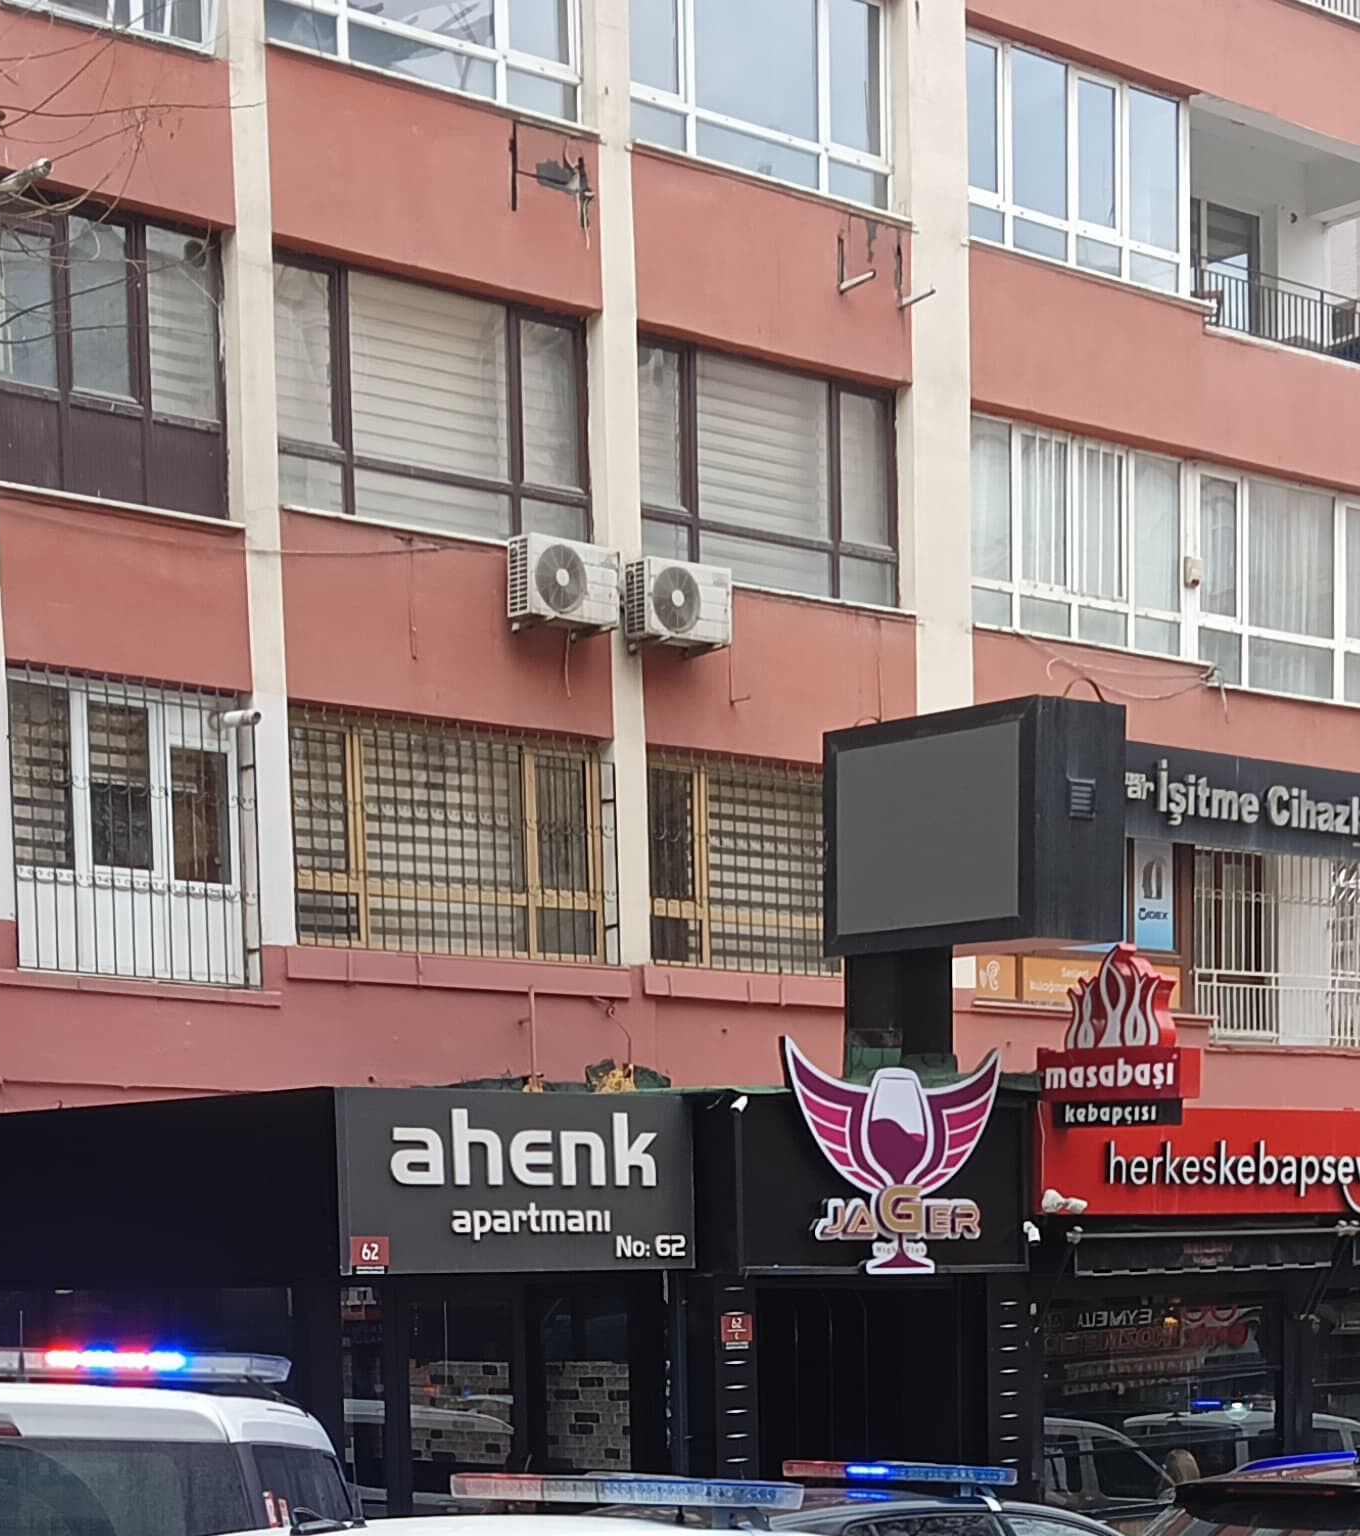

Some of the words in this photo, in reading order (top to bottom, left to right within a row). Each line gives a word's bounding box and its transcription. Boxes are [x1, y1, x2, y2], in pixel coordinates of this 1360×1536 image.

[1157, 758, 1260, 826] İşitme
[1045, 1058, 1175, 1090] masabaşı
[1065, 1104, 1157, 1126] kebapçısı
[391, 1108, 658, 1187] ahenk
[452, 1203, 612, 1241] apartmanı
[361, 1242, 380, 1261] 62
[615, 1235, 651, 1258] No:
[654, 1234, 687, 1257] 62
